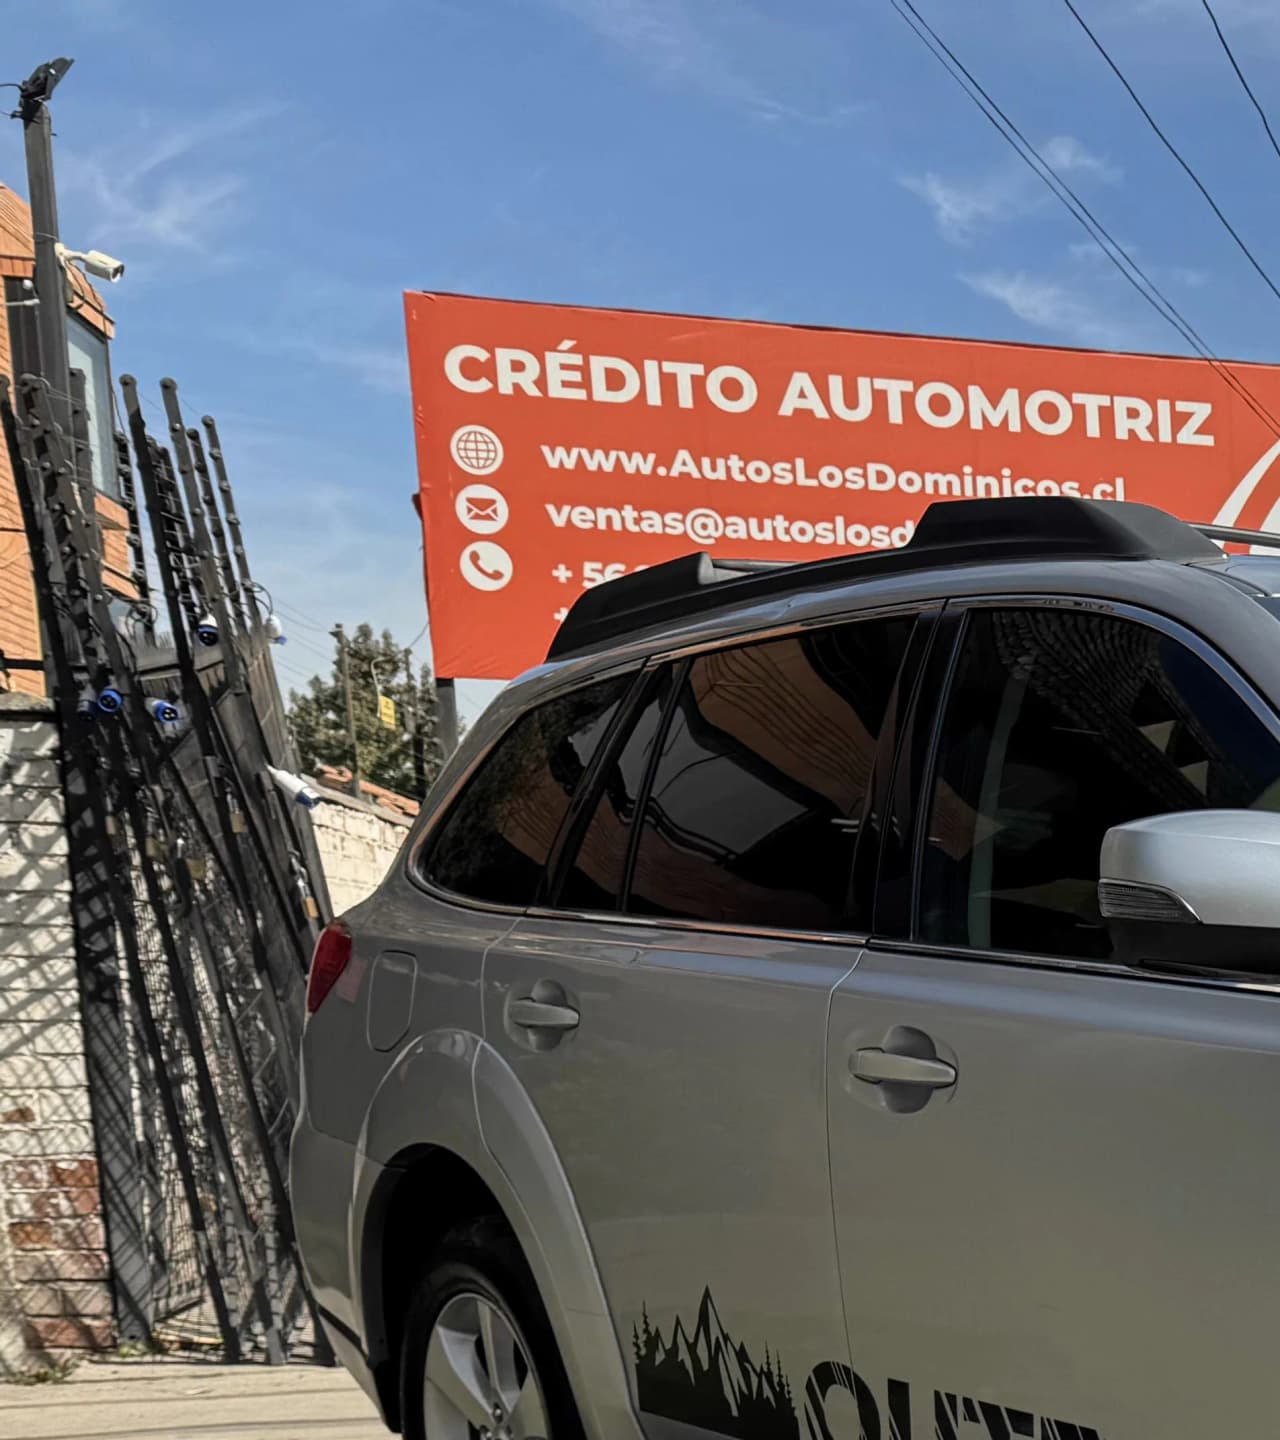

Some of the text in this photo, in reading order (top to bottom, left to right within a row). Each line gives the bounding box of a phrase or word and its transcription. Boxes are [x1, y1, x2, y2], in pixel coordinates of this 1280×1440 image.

[444, 340, 1215, 447] CRÉDITO AUTOMOTRIZ
[540, 444, 1125, 501] www.AutosLosDominicos.cl
[545, 502, 915, 549] ventas@autoslosd
